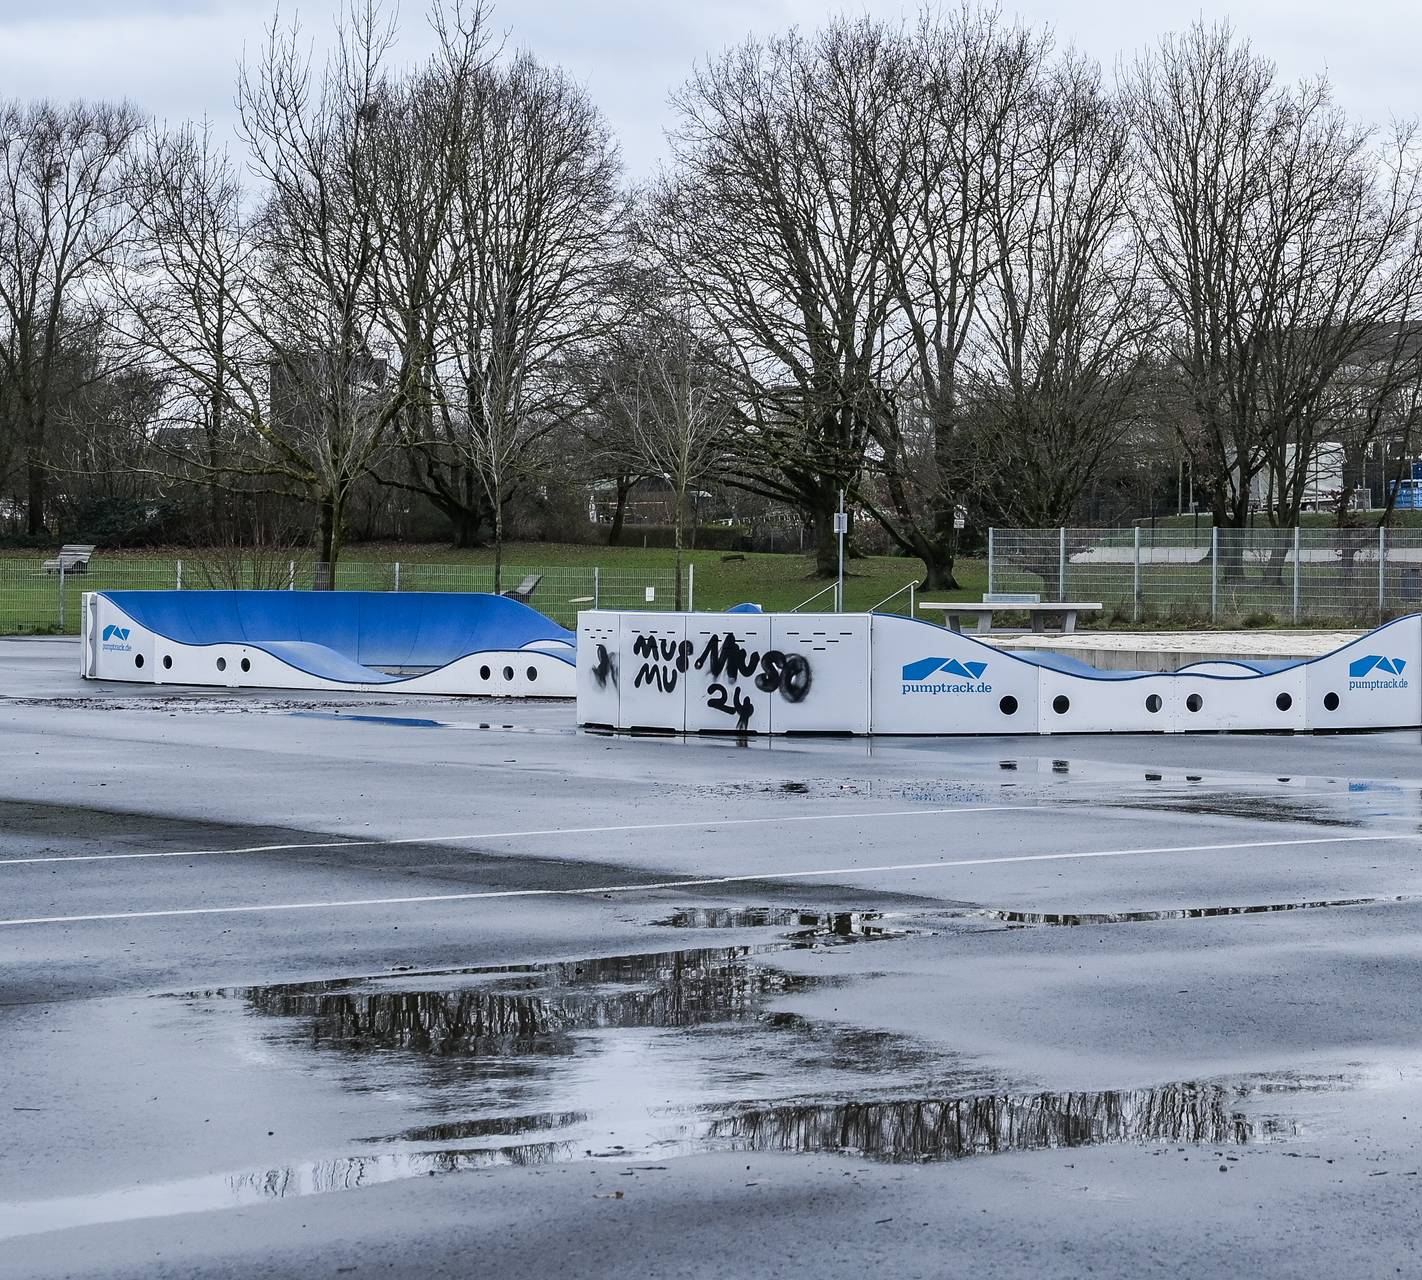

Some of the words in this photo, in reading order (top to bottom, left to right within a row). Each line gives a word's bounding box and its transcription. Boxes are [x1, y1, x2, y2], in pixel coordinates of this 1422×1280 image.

[902, 682, 992, 694] pumptrack.de
[1349, 678, 1409, 691] pumptrack.de
[707, 683, 755, 729] 24
